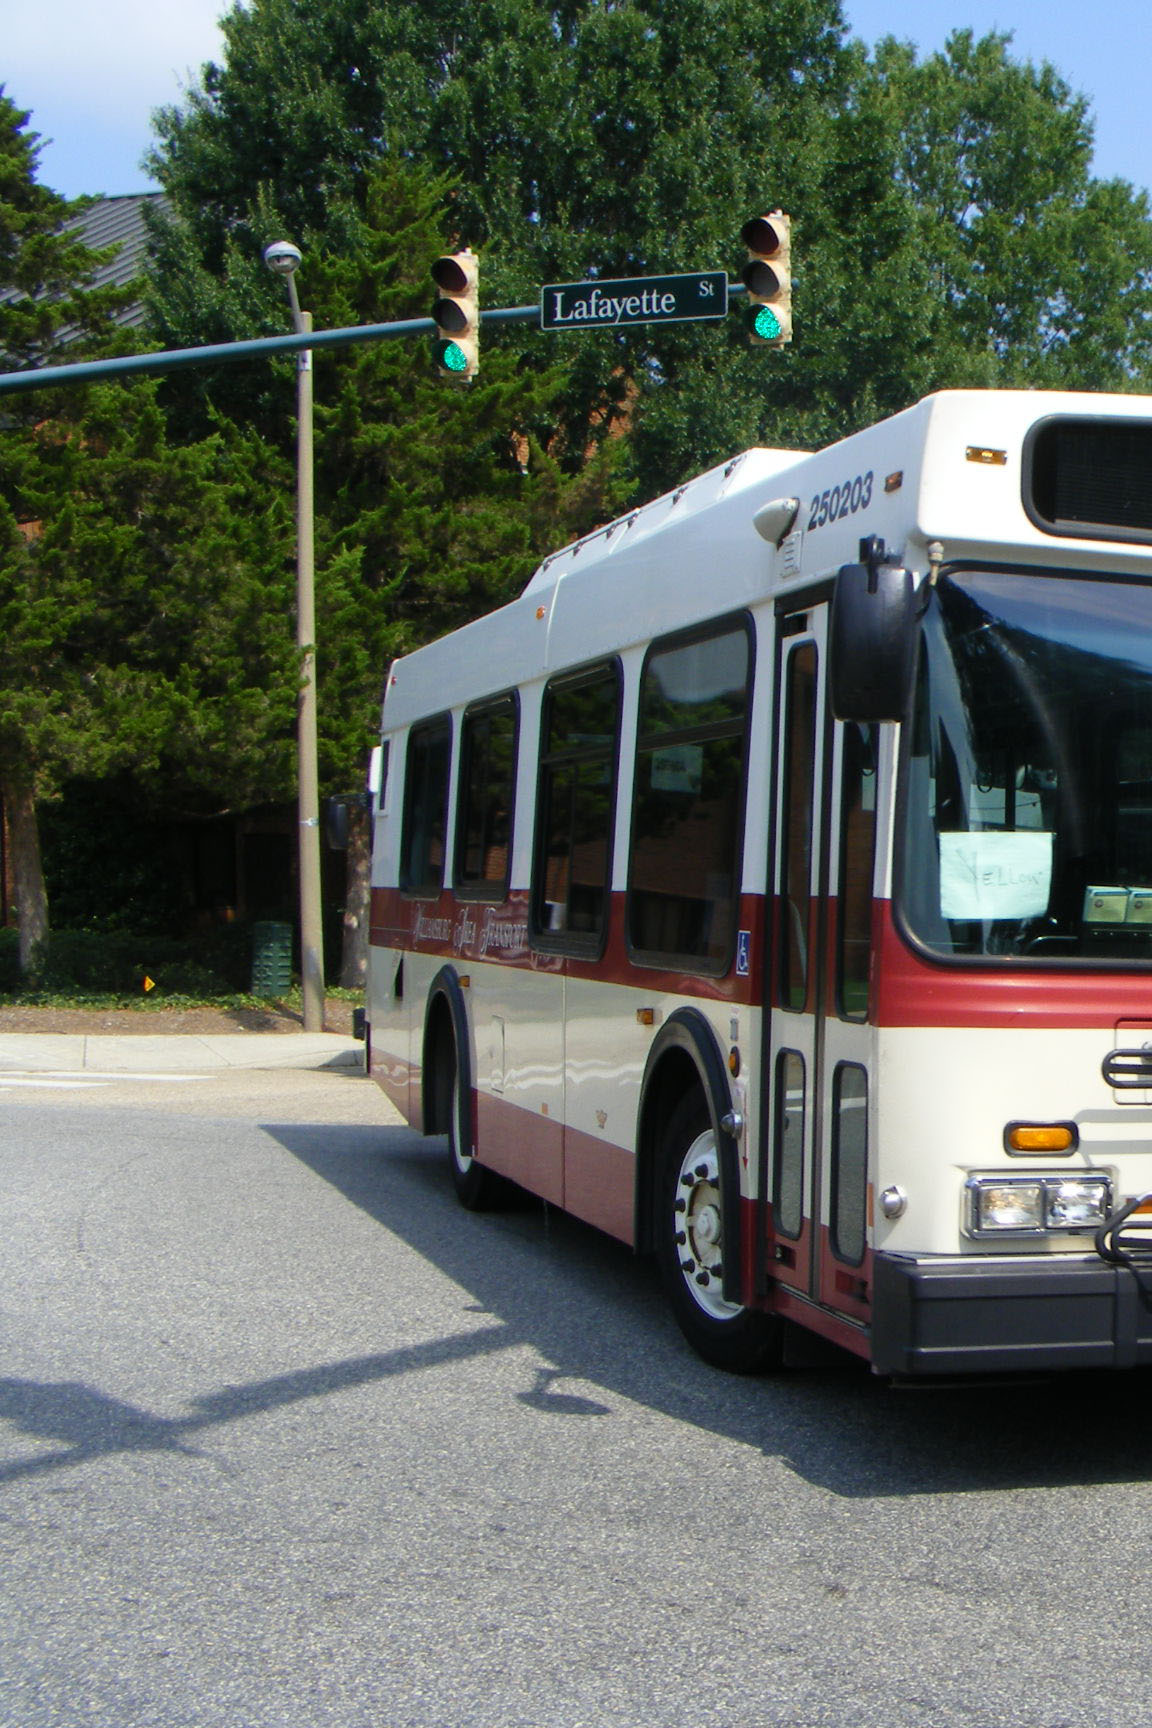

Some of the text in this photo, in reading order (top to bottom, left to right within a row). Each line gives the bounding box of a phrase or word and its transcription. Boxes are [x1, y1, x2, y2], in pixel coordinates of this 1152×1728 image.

[553, 280, 714, 324] Lafayette St
[808, 470, 874, 532] 250203
